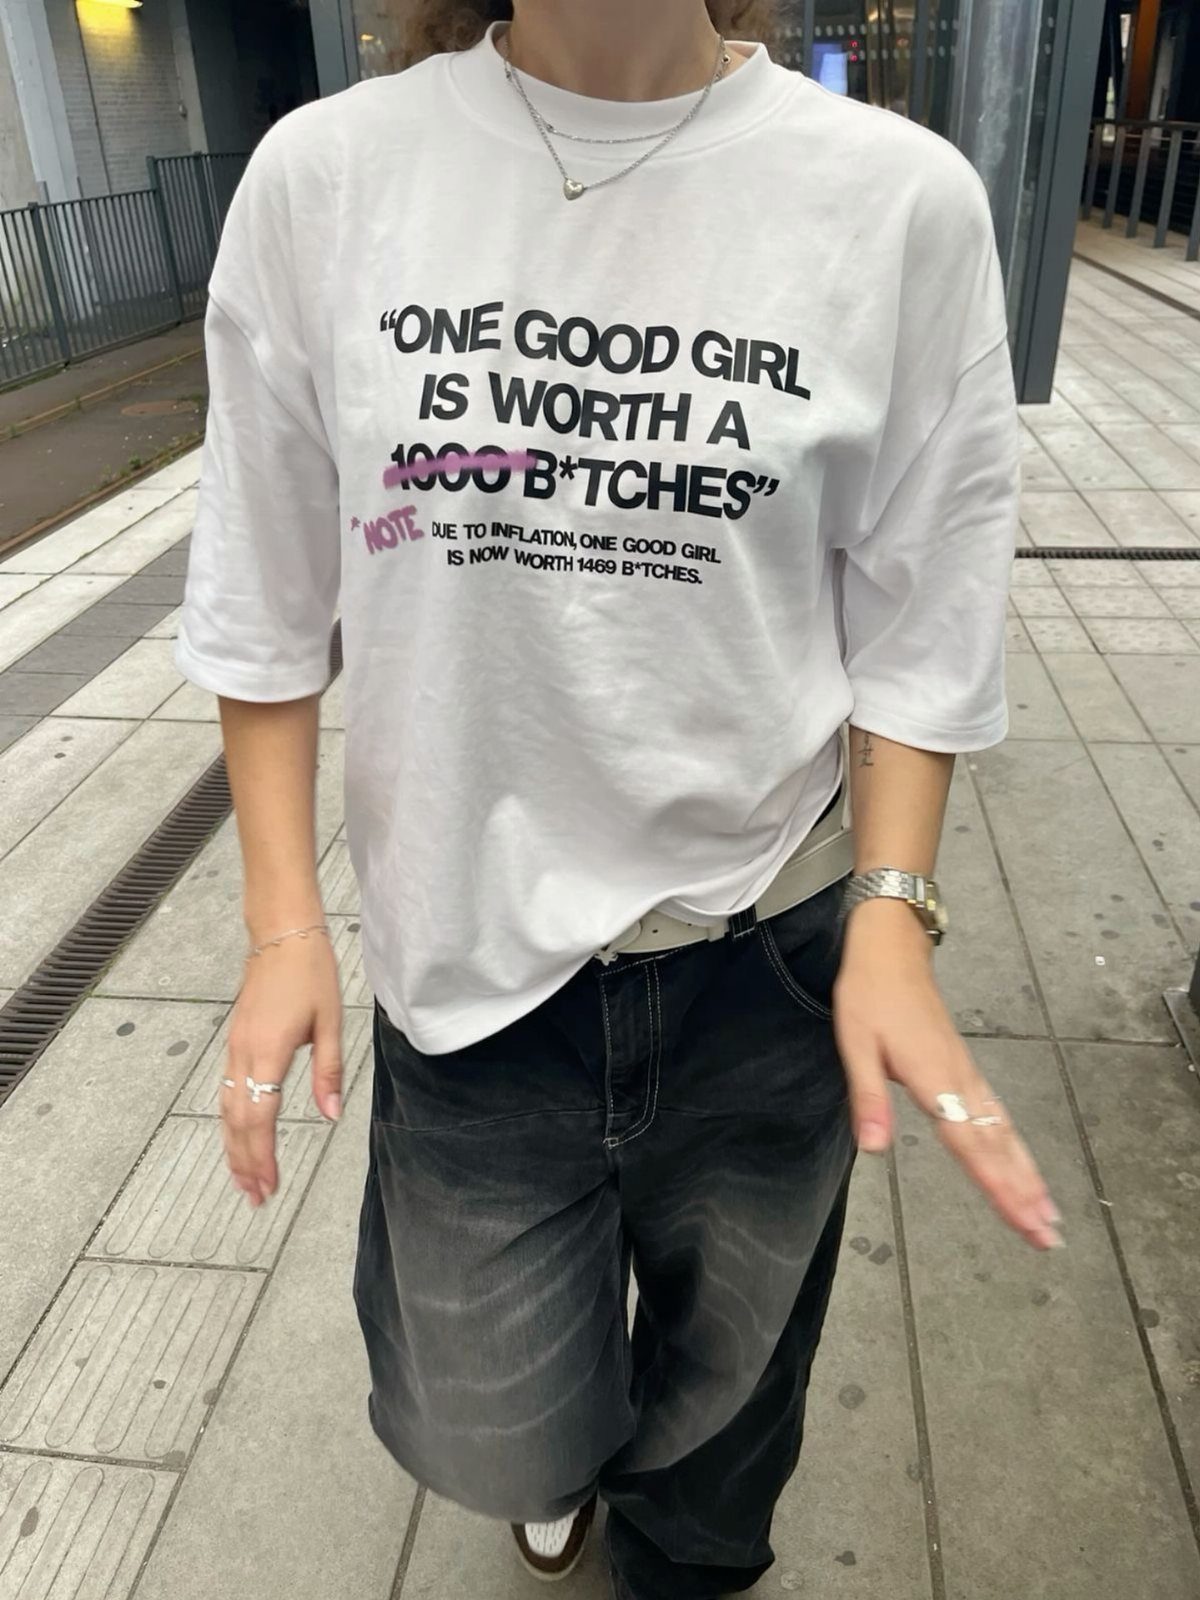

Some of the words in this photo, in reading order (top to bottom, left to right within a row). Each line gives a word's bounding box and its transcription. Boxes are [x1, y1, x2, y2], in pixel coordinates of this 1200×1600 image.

[380, 301, 504, 354] “ONE
[514, 309, 680, 374] GOOD
[691, 329, 811, 401] GIRL
[418, 373, 470, 420] IS
[488, 371, 692, 442] WORTH
[706, 400, 752, 451] A
[391, 442, 512, 494] 1000
[431, 521, 458, 540] DUE
[463, 522, 487, 540] TO
[490, 521, 577, 551] INFLATION,
[579, 533, 618, 551] ONE
[622, 537, 677, 556] GOOD
[681, 543, 722, 564] GIRL
[447, 549, 464, 566] IS
[469, 545, 510, 565] NOW
[513, 548, 574, 572] WORTH
[577, 557, 617, 575] 1469
